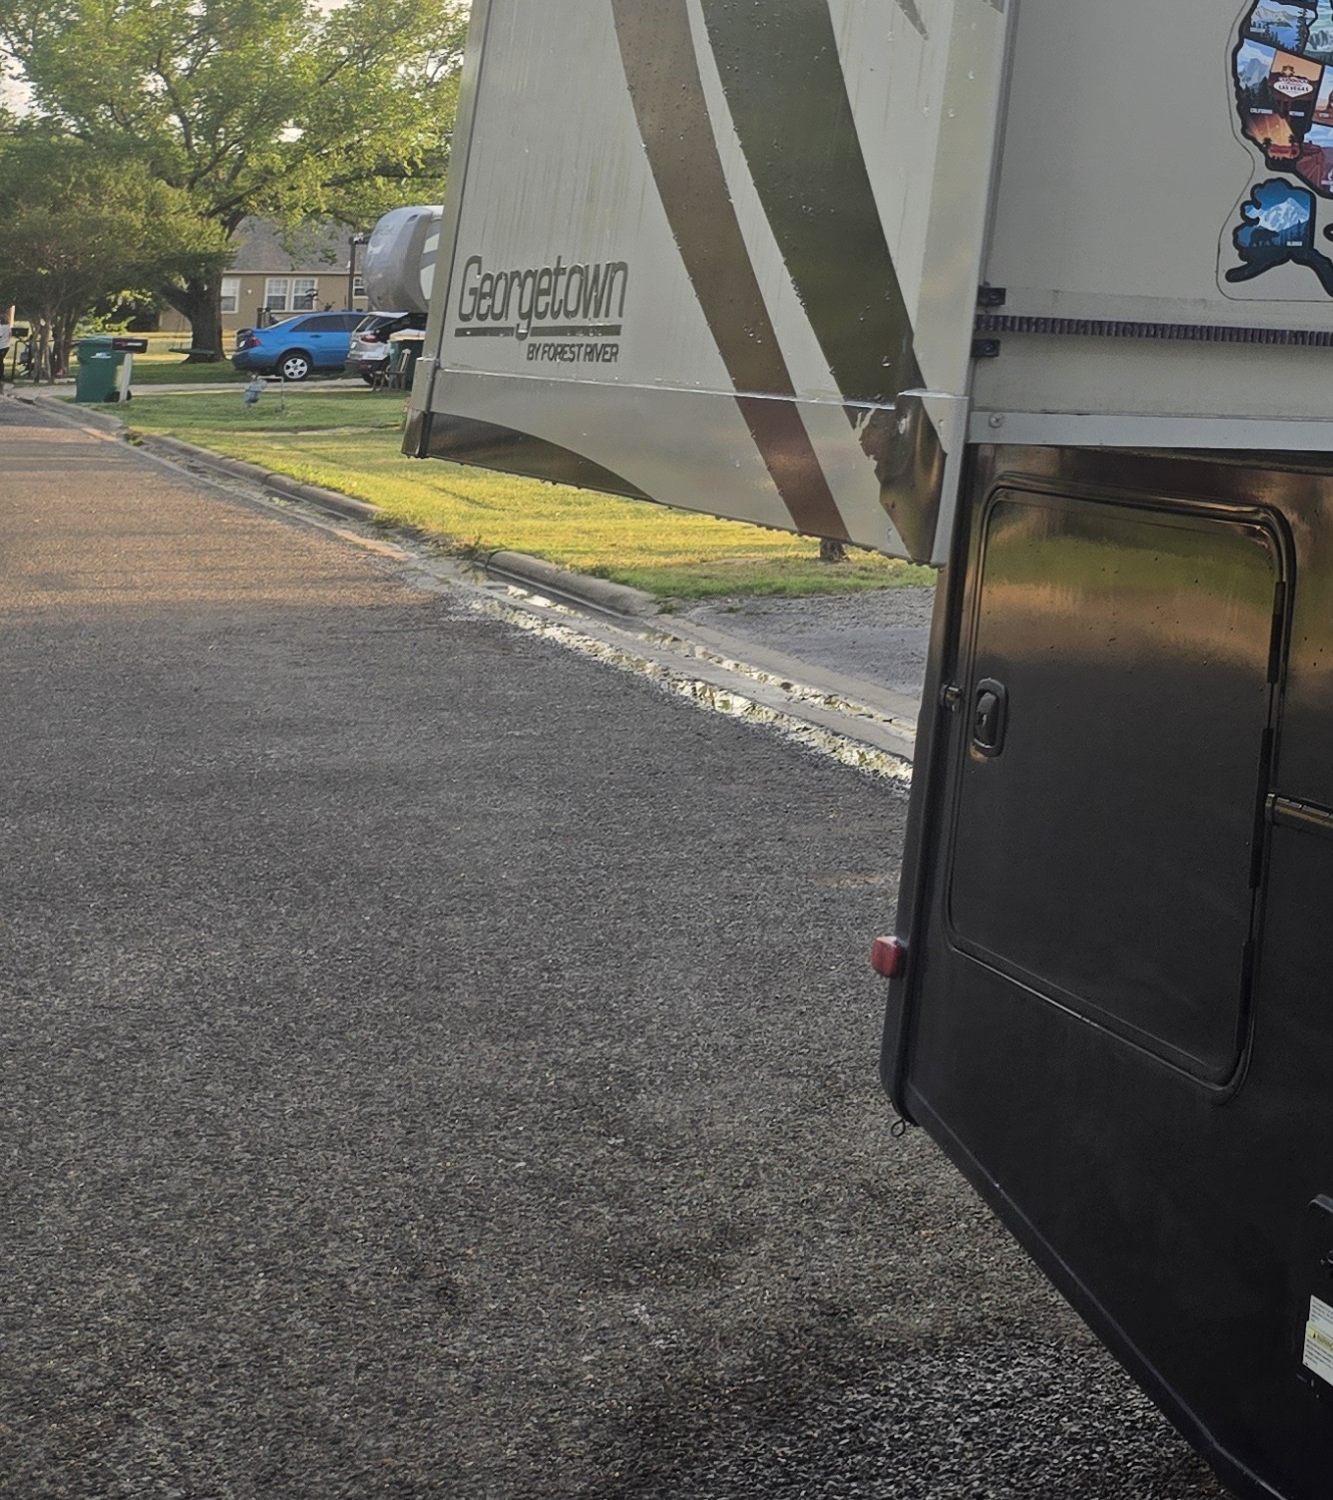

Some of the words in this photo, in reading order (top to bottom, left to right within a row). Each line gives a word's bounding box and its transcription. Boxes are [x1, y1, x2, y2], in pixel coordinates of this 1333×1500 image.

[459, 255, 629, 341] Georgetown
[526, 343, 541, 361] BY
[541, 343, 582, 363] FOREST
[582, 343, 620, 363] RIVER
